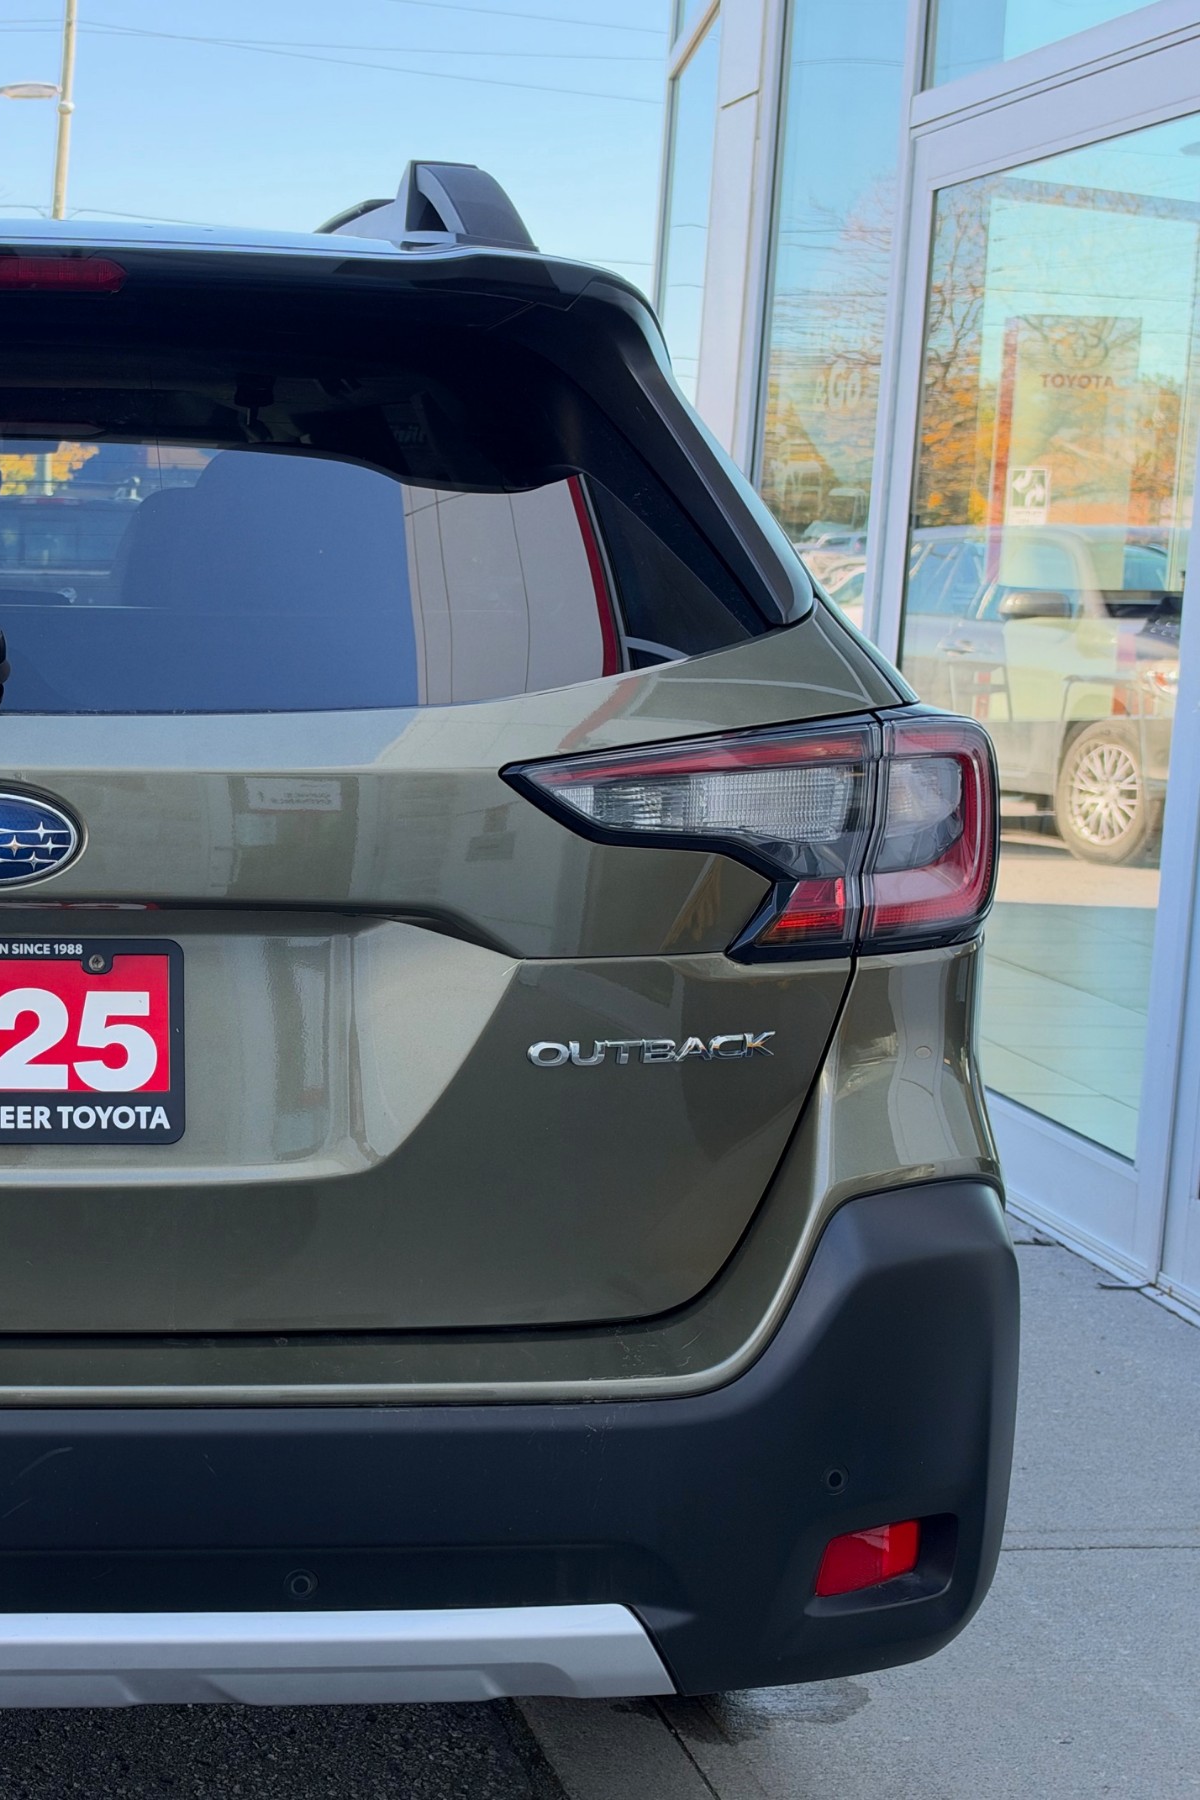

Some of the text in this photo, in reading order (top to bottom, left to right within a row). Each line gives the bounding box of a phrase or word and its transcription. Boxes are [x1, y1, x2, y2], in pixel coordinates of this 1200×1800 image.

[1040, 373, 1115, 390] TOYOTA
[11, 942, 51, 956] SINCE
[53, 942, 84, 956] 1988
[526, 1030, 776, 1067] OUTBACK
[56, 1105, 171, 1130] TOYOTA
